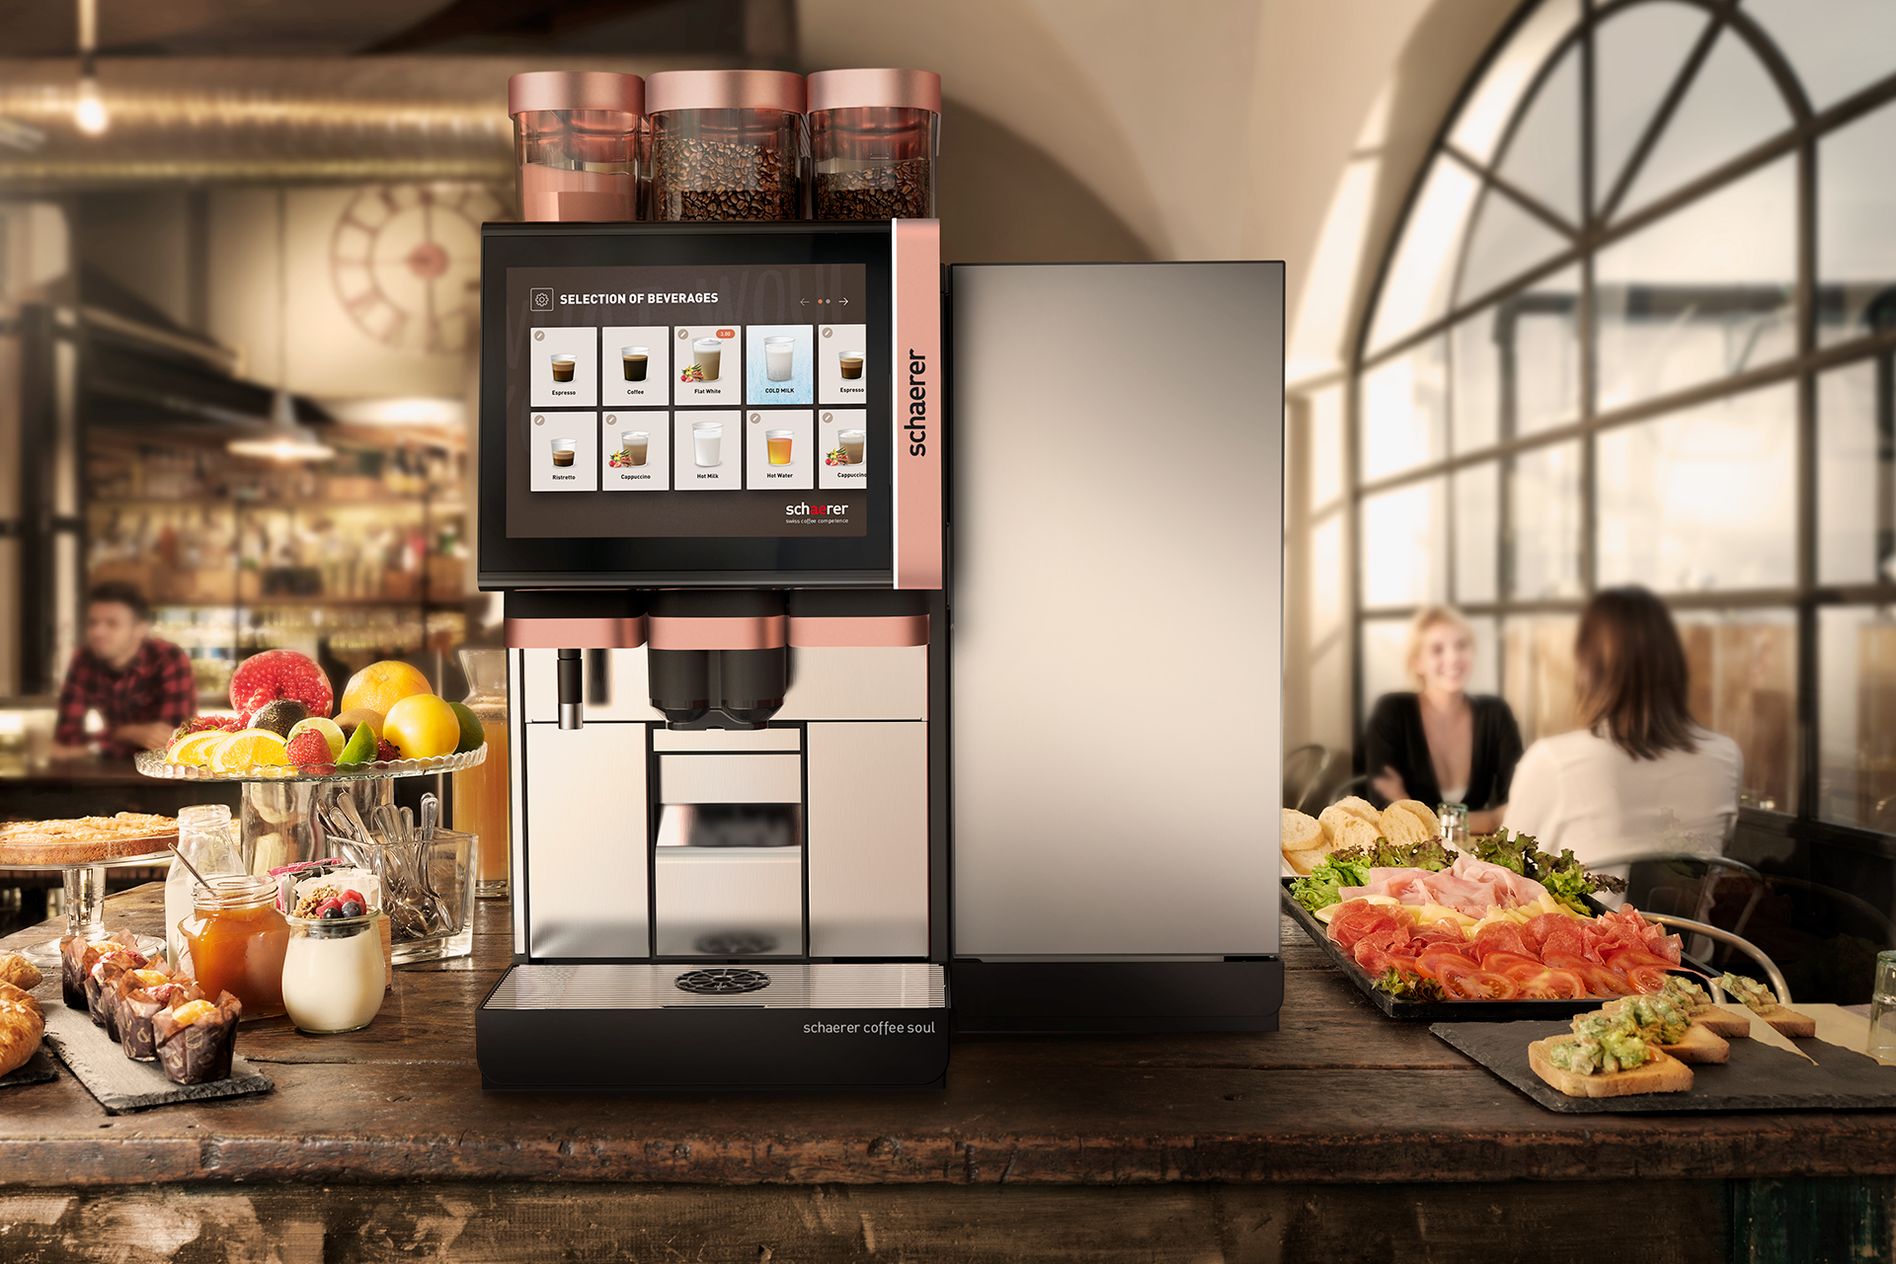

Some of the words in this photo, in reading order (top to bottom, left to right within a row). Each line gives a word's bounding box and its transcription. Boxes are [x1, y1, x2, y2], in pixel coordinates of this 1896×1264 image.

[559, 293, 626, 305] SELECTION
[628, 293, 645, 304] OF
[647, 292, 719, 304] BEVERAGES
[551, 389, 577, 397] Espresso
[904, 348, 926, 457] schaerer
[620, 473, 651, 481] Cappuccino
[785, 501, 849, 516] schaerer
[803, 1021, 861, 1034] schaerer
[863, 1020, 905, 1036] coffee
[907, 1021, 936, 1034] soul
